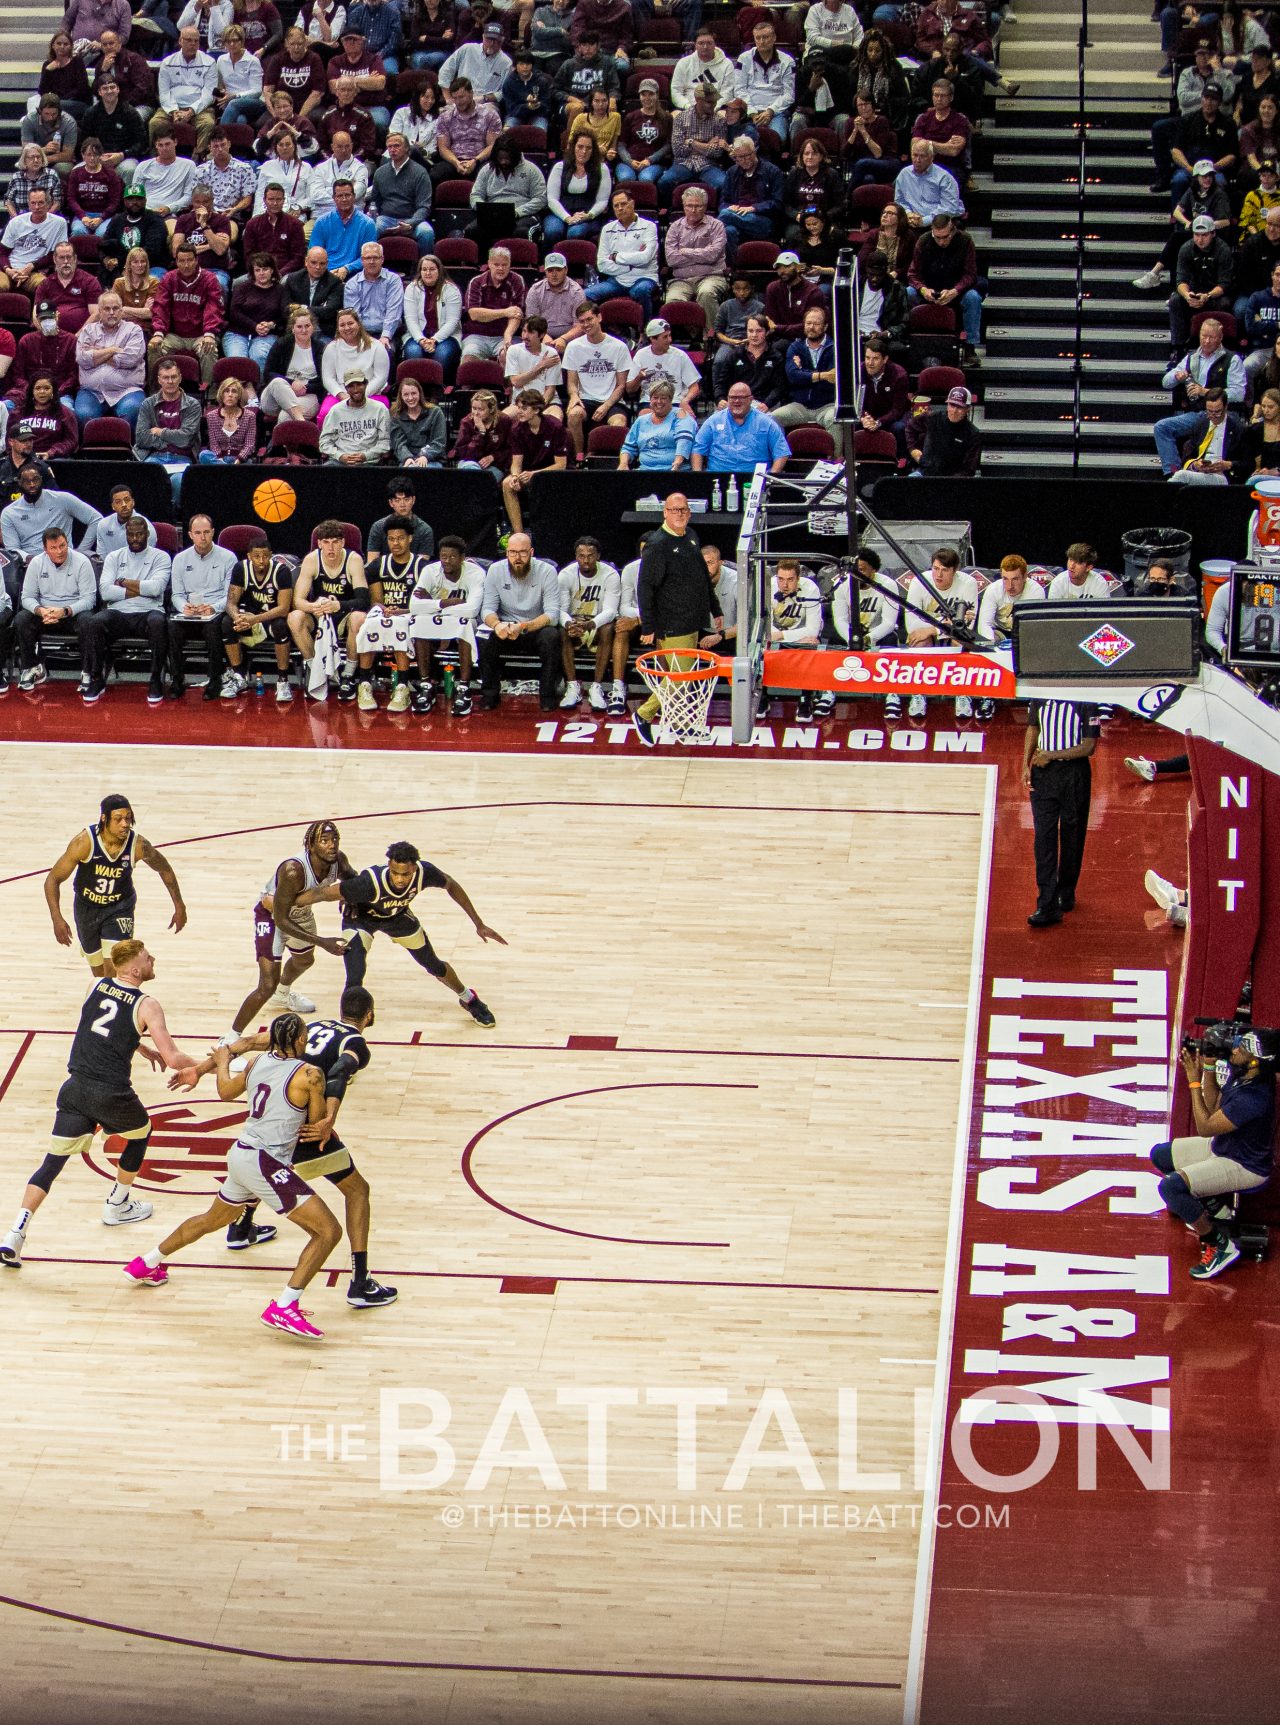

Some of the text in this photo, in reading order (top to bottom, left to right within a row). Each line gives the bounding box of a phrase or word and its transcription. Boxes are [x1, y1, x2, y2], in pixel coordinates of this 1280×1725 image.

[339, 420, 361, 433] TEXAS
[322, 581, 345, 595] WAKE
[383, 581, 408, 592] WAKE
[581, 585, 601, 602] ALL
[252, 590, 274, 603] WAKE
[779, 603, 802, 619] ALL
[1093, 641, 1122, 650] NIT
[95, 864, 123, 878] WAKE
[95, 878, 115, 894] 31
[83, 887, 122, 905] FOREST
[383, 898, 411, 909] WAKE
[96, 982, 136, 1006] HILDRETH
[91, 998, 118, 1038] 2
[251, 1083, 271, 1119] 0
[959, 968, 1171, 1431] TEXAS A&M
